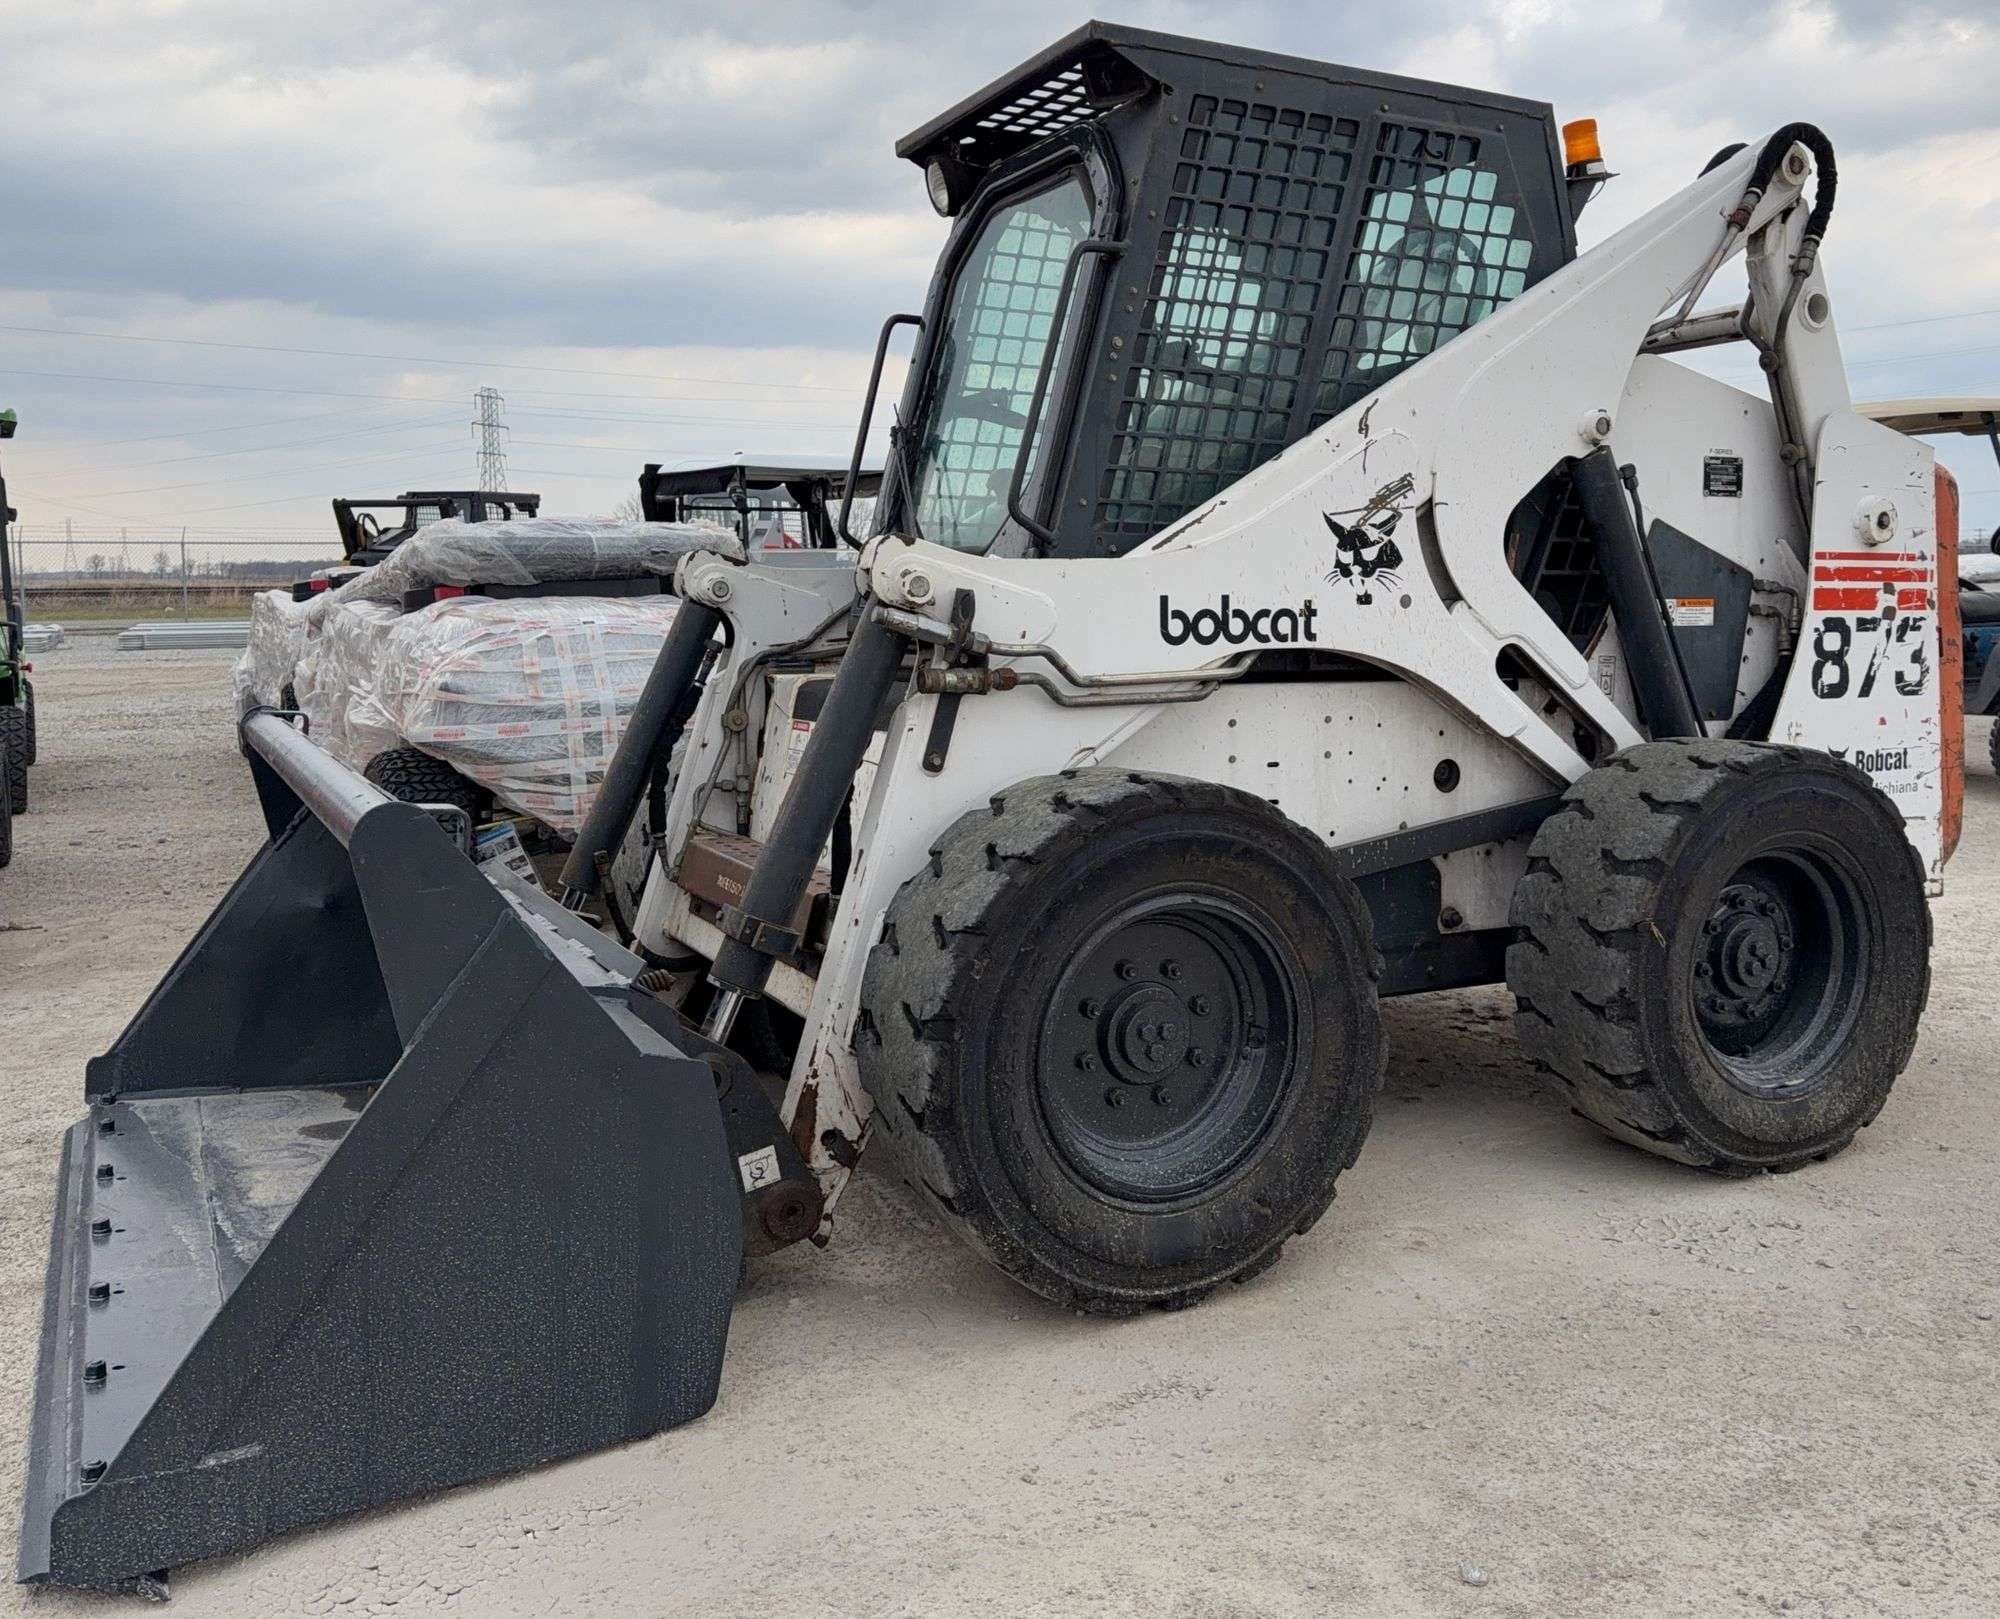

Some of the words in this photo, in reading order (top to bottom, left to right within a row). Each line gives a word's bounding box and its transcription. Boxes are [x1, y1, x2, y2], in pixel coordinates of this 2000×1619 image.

[1160, 594, 1318, 646] bobcat
[1811, 616, 1931, 700] 873
[1855, 748, 1908, 772] Bobcat
